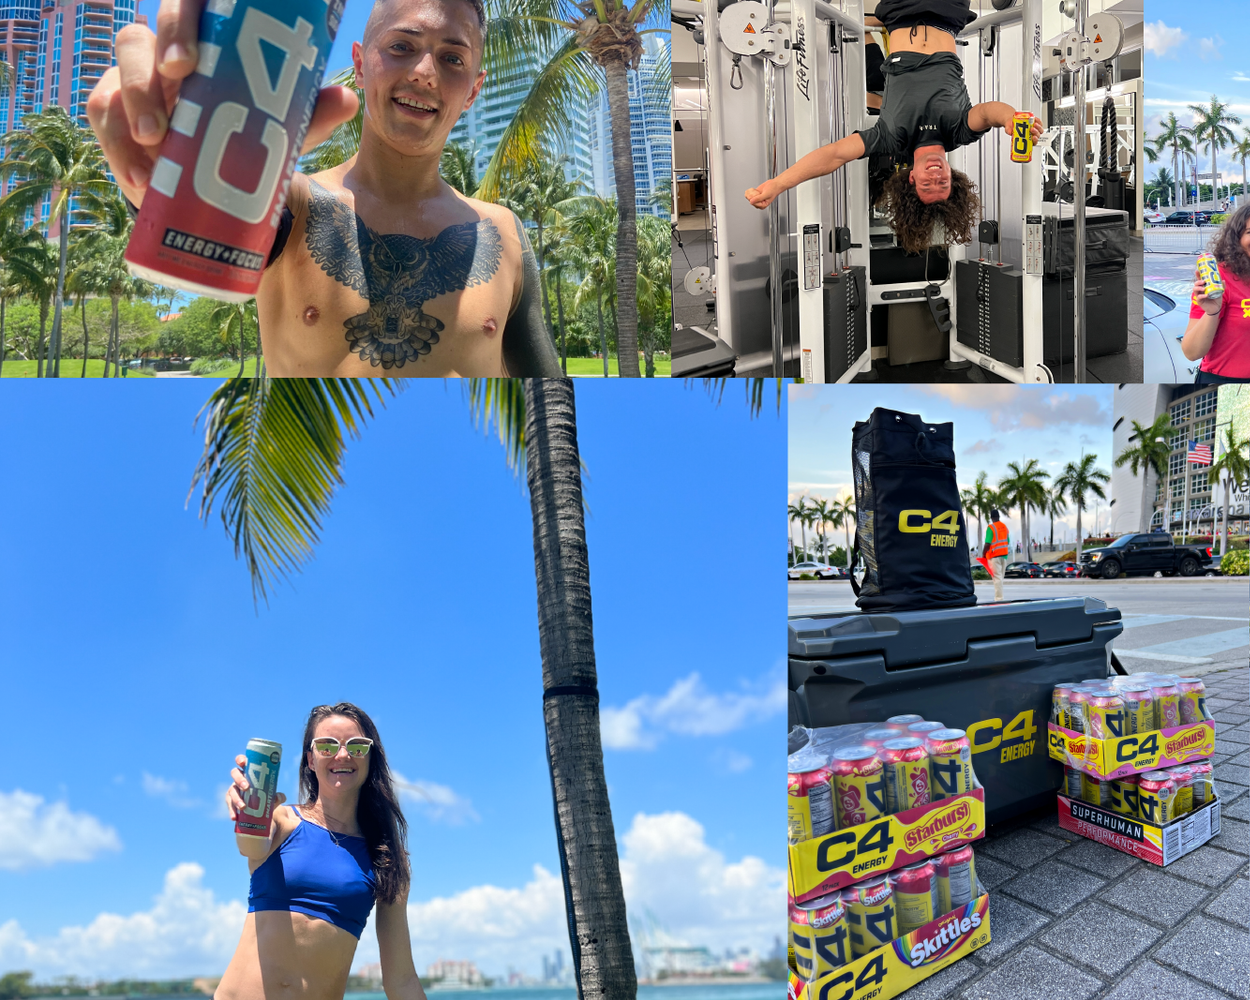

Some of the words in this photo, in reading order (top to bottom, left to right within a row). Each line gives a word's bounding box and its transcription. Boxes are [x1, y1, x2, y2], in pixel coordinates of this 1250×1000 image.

[193, 5, 320, 225] C4
[1013, 121, 1030, 155] C4
[1206, 260, 1222, 285] C4
[897, 509, 961, 535] C4
[930, 534, 959, 548] ENERGY
[965, 709, 1038, 756] C4
[1116, 733, 1160, 763] C4
[1165, 727, 1206, 758] Starburst
[1000, 739, 1036, 764] ENERGY
[1135, 757, 1156, 768] ENERGY
[242, 761, 270, 819] C4
[816, 819, 895, 873] C4
[905, 802, 971, 852] Starburst
[1072, 804, 1142, 840] SUPERHUMAN
[1077, 821, 1139, 852] PERFORMANCE
[852, 854, 888, 875] ENERGY
[942, 831, 960, 843] Cherry
[863, 887, 894, 906] Skittles
[812, 906, 845, 928] Skittles
[818, 952, 888, 1000] C4
[909, 911, 982, 969] Skittles
